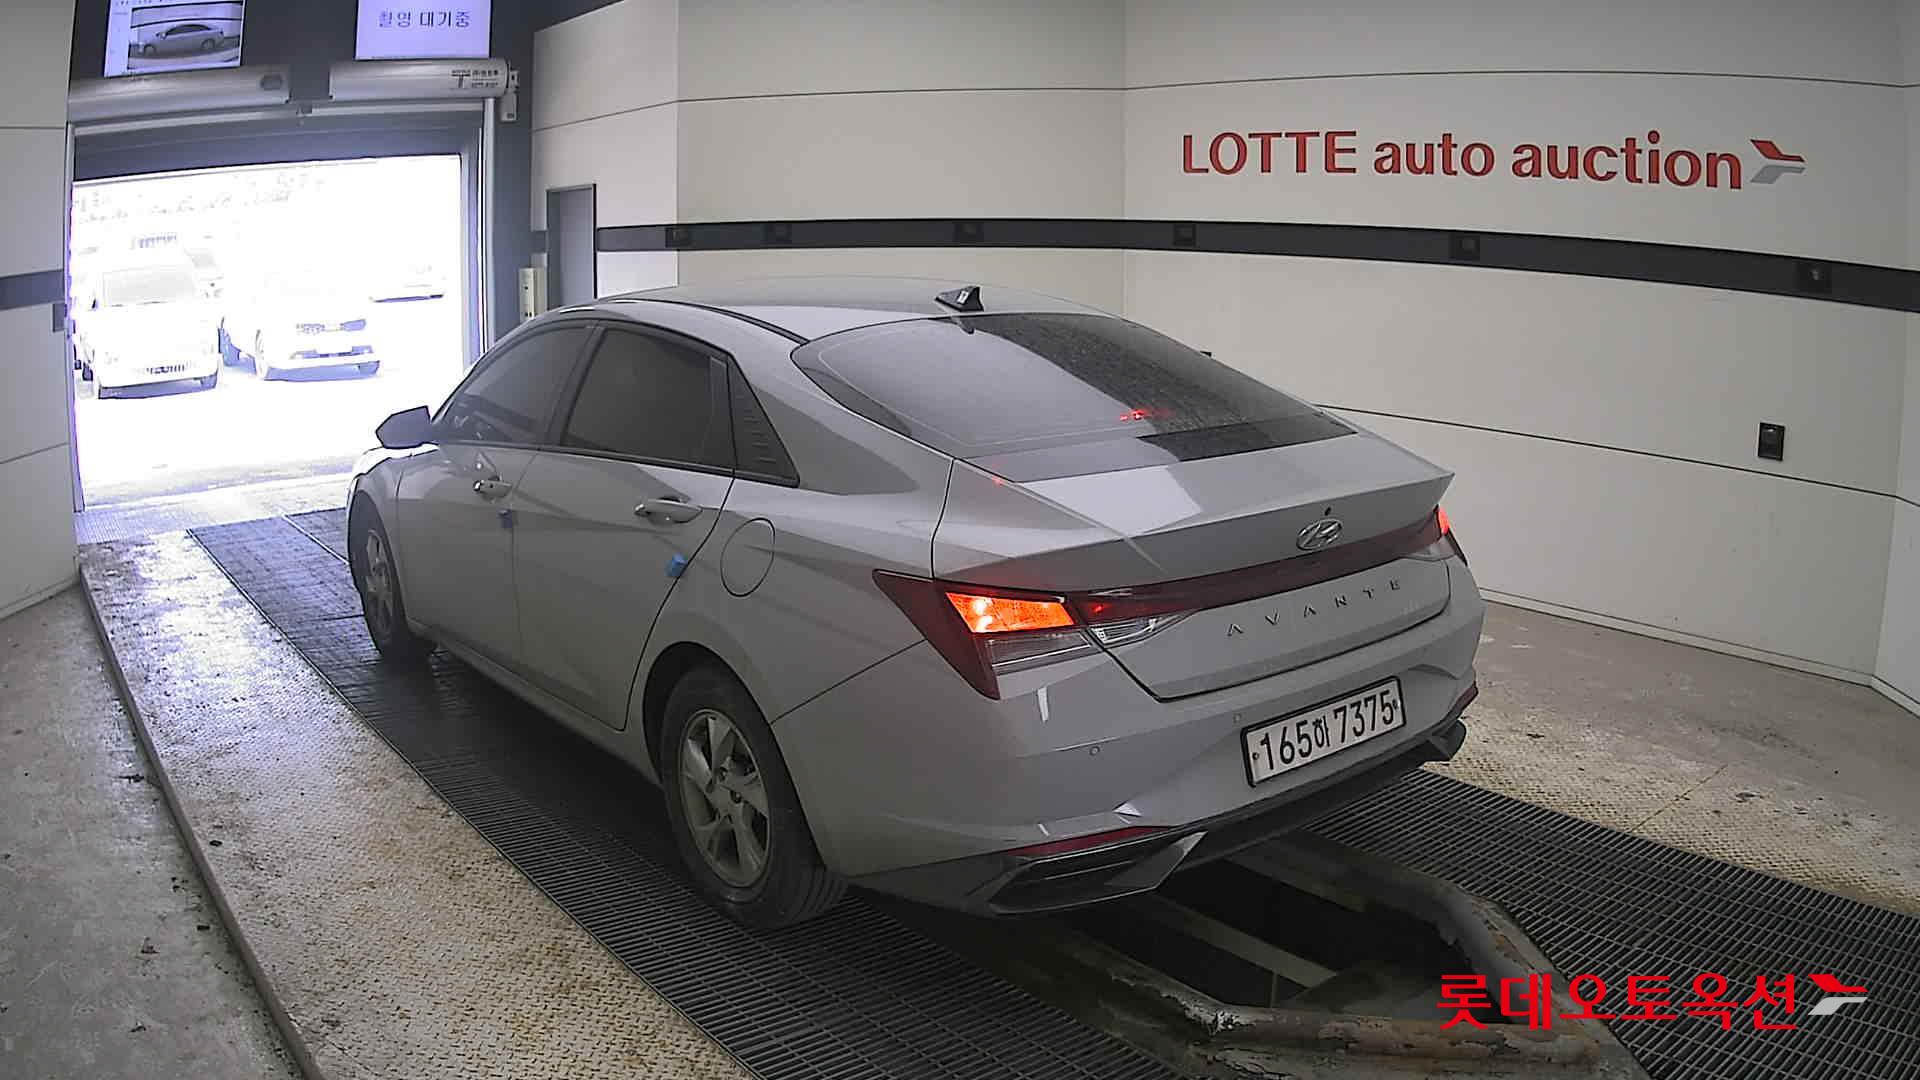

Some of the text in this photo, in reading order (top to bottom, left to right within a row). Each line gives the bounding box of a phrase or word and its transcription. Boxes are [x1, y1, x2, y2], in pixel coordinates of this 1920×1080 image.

[378, 9, 471, 28] 영 대기중
[1183, 130, 1743, 190] LOTTE auto auction
[1227, 578, 1401, 637] AVANTE
[1259, 689, 1395, 771] 165하 7375
